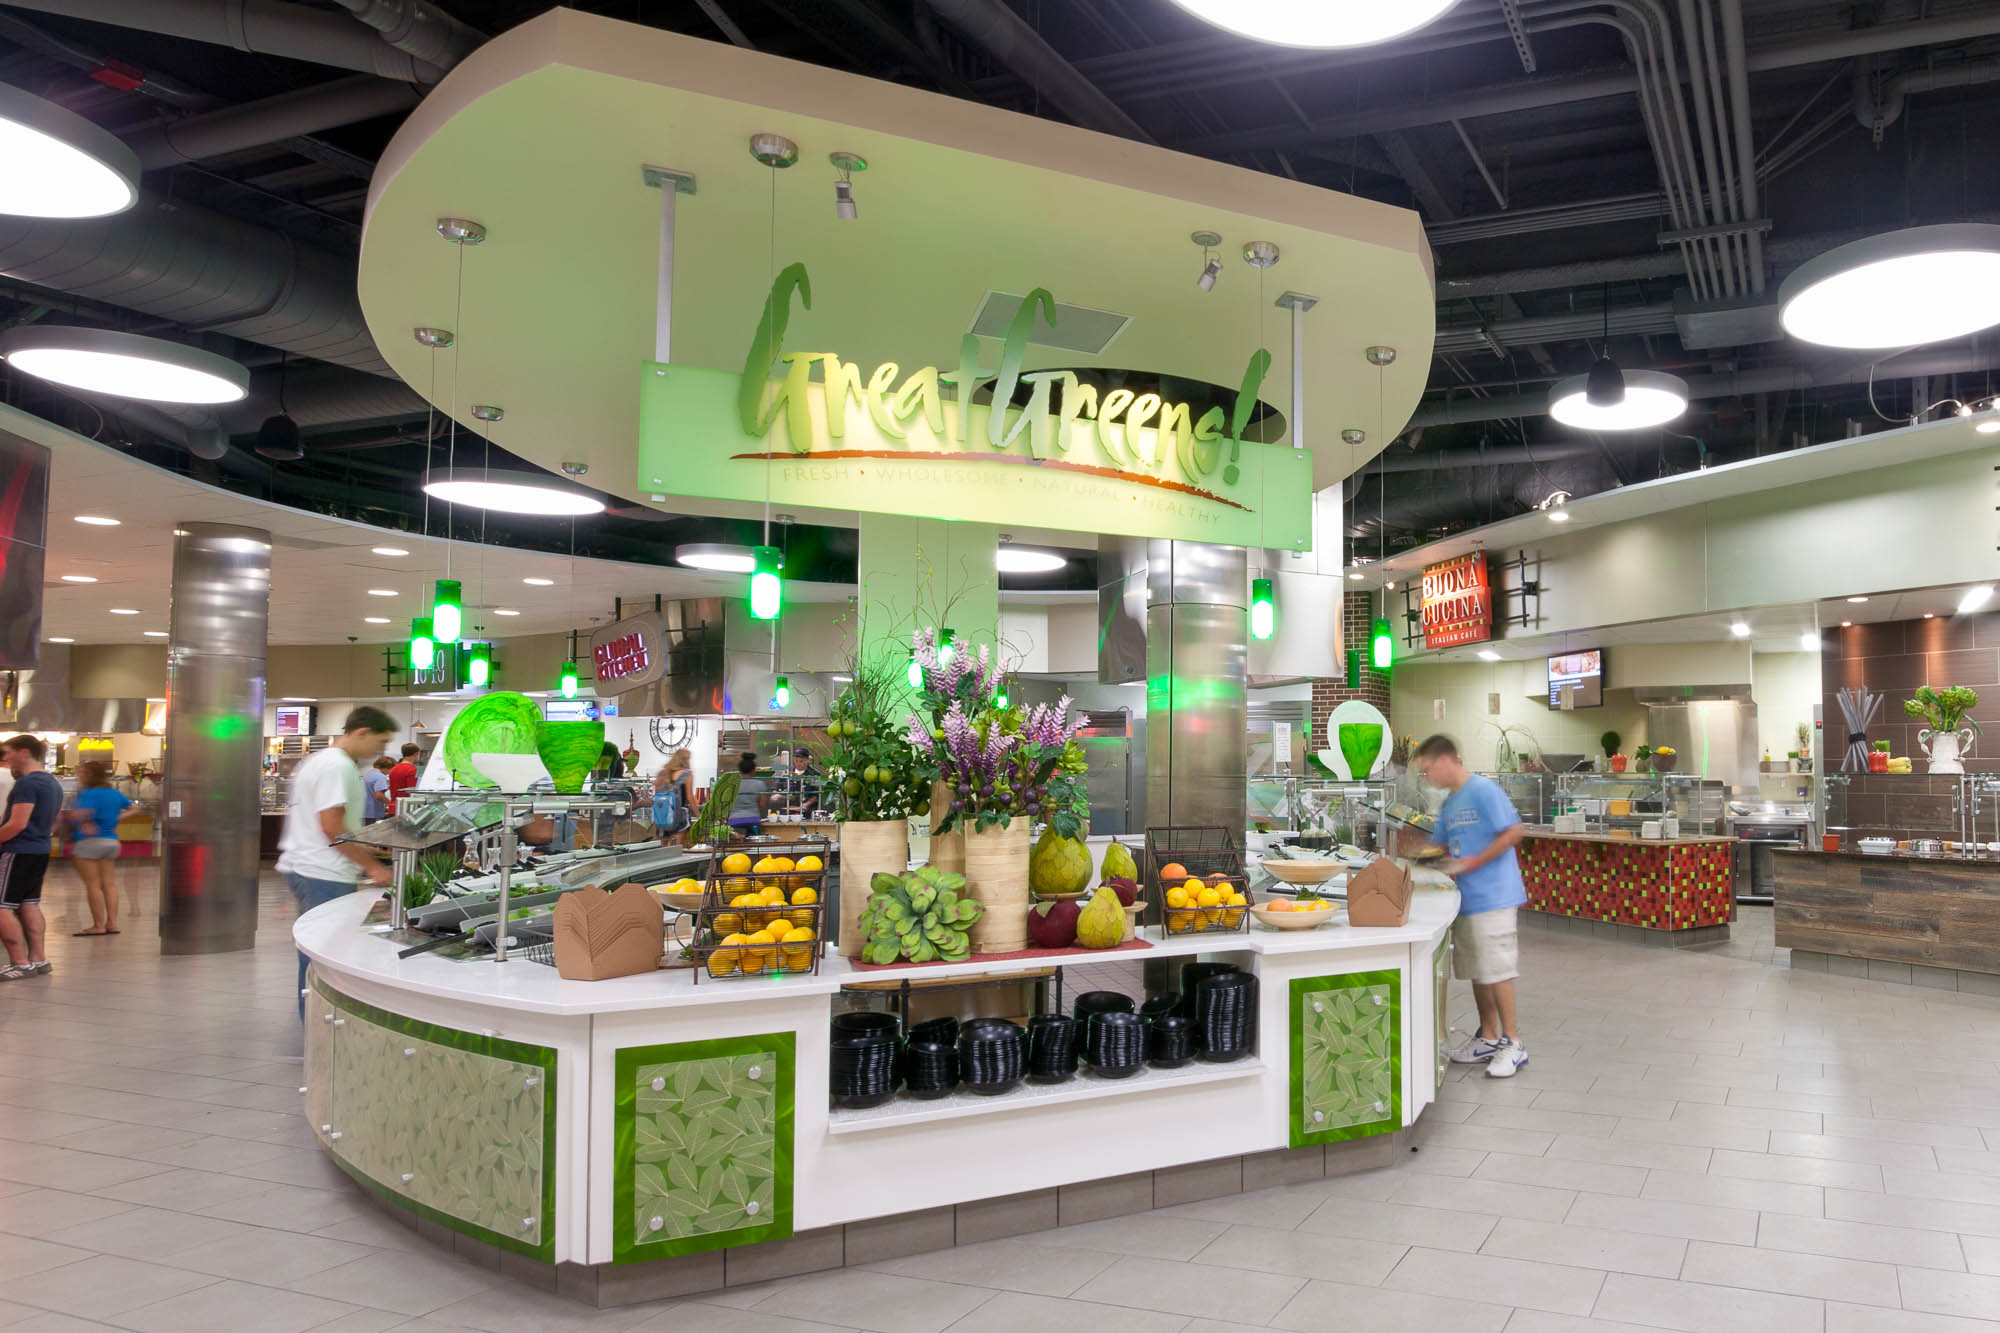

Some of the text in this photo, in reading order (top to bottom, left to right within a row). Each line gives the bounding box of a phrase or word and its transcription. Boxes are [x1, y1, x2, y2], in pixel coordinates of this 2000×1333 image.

[738, 262, 1272, 484] Great Greens!
[783, 466, 1222, 525] FRESH WHOLESOME NATURAL HEALTHY
[1423, 564, 1479, 598] BUONA
[1423, 593, 1482, 626] CUCINA
[1431, 632, 1458, 645] ITALIAN
[596, 651, 648, 681] KITCHEN
